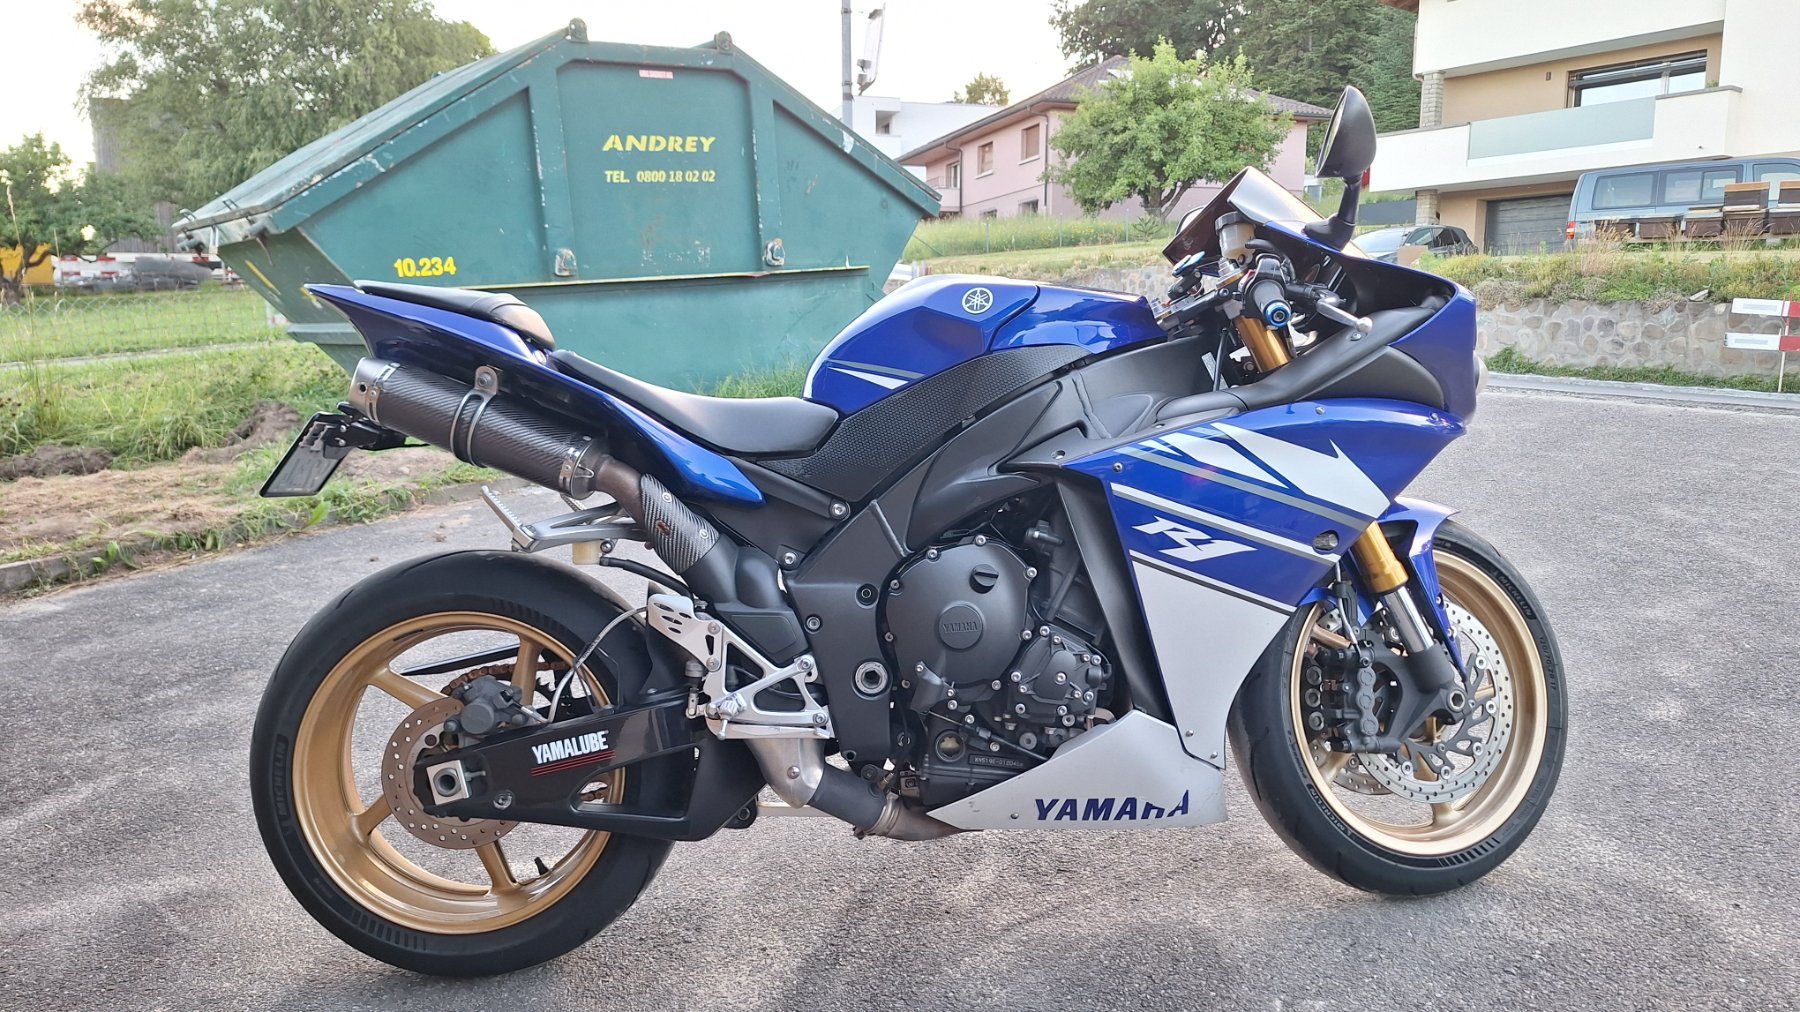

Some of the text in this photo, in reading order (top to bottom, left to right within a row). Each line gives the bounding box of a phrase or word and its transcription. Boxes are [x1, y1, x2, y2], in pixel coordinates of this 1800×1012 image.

[602, 134, 716, 153] ANDREY
[604, 170, 716, 183] TEL. 0800 18 02 02
[393, 256, 457, 278] 10.234
[1131, 515, 1258, 562] R1
[1500, 574, 1533, 617] MICHELIN
[942, 621, 978, 633] YAMAHA
[531, 730, 609, 765] YAMALUBE
[272, 741, 289, 816] MICHELIN
[1035, 789, 1189, 821] YAMAHA
[1309, 786, 1346, 832] MICHELIN
